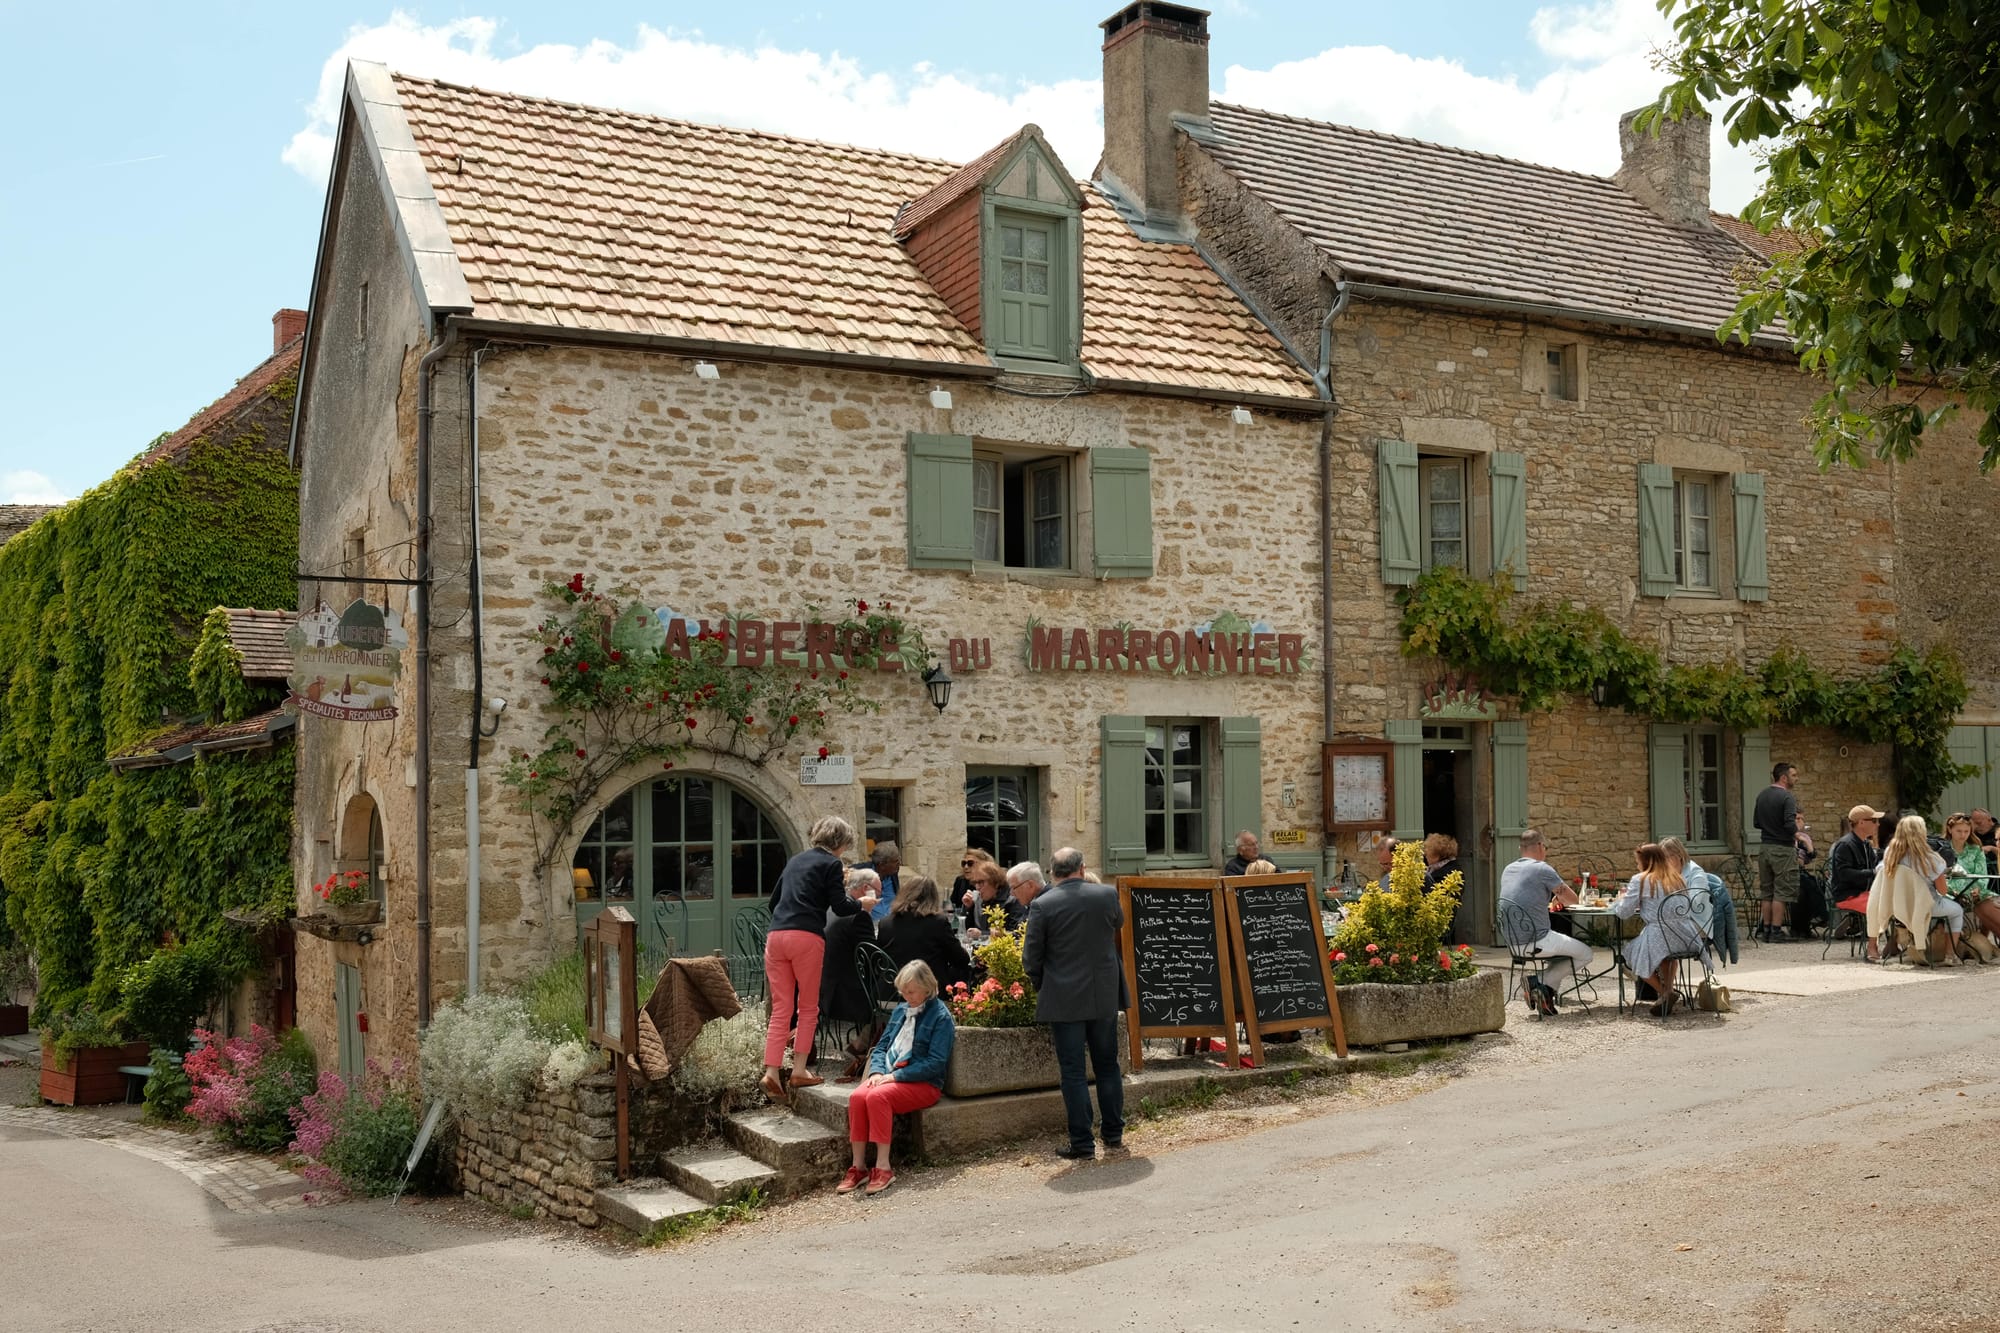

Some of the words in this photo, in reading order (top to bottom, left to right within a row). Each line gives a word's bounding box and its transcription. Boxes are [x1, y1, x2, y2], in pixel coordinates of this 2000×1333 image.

[318, 650, 391, 668] MARRONNIER
[949, 637, 992, 671] DU
[1030, 627, 1303, 673] MARRONNIER
